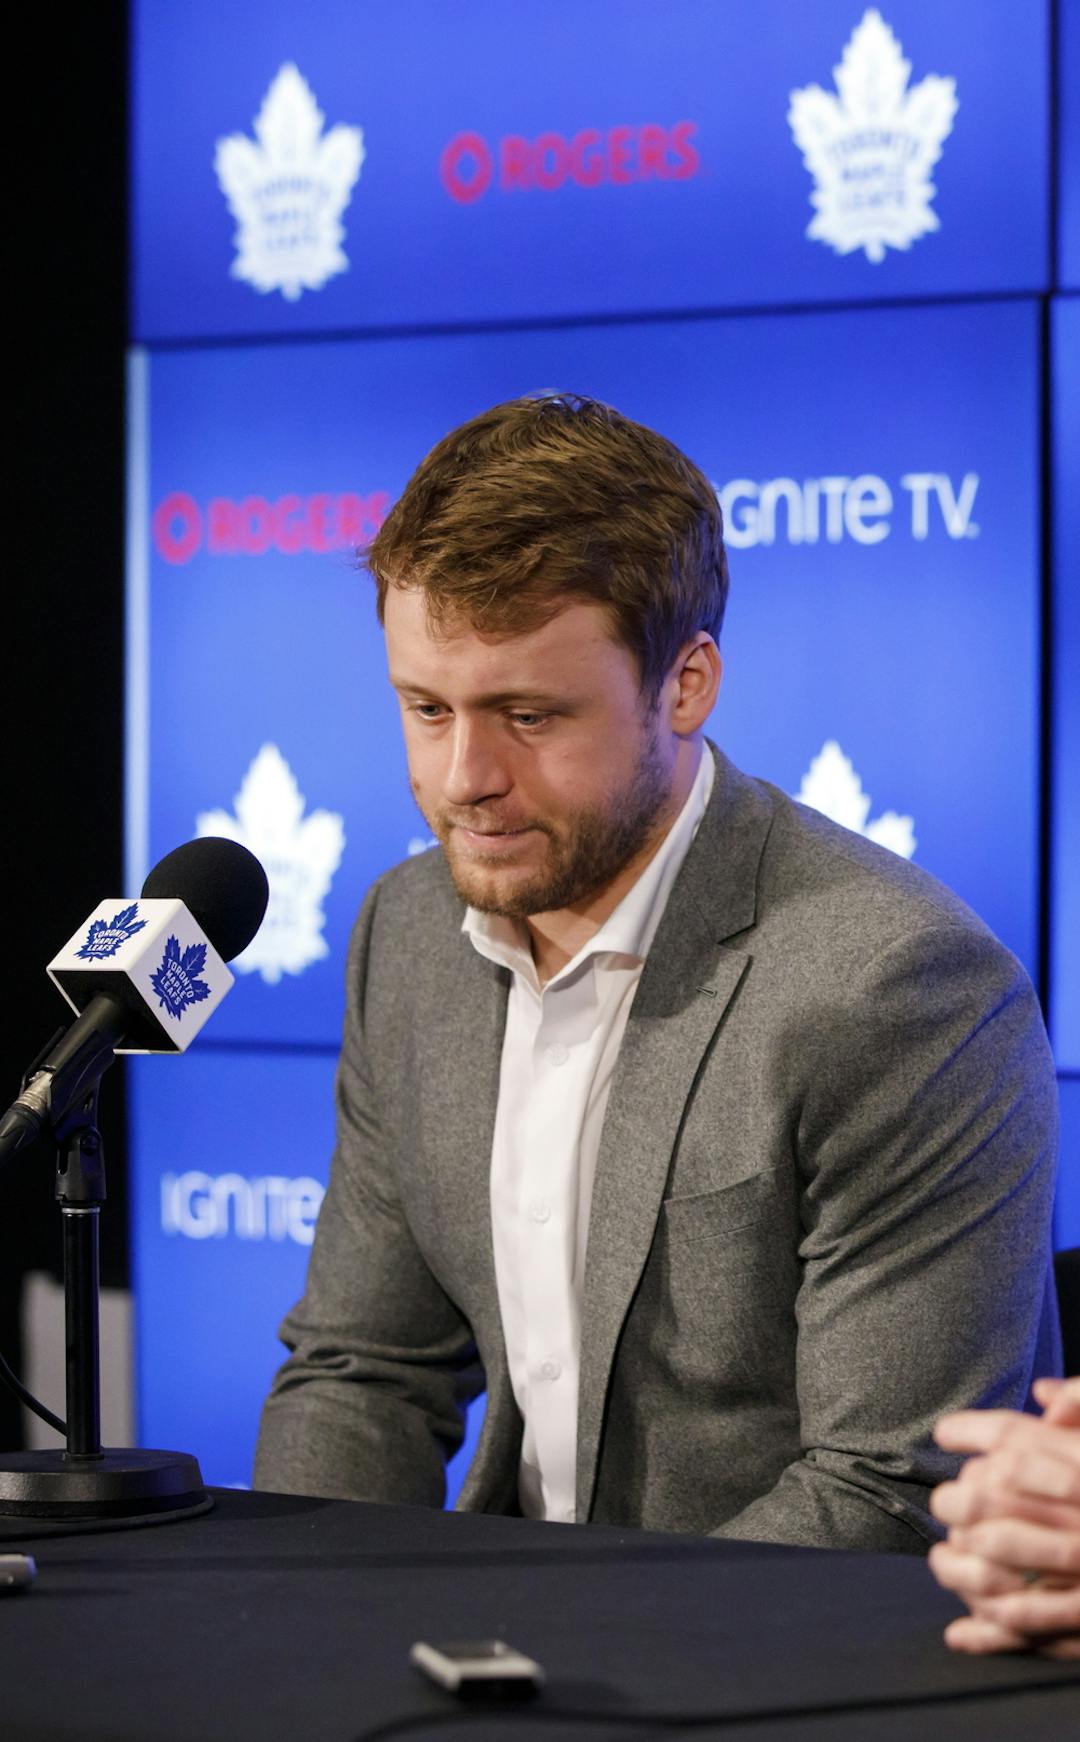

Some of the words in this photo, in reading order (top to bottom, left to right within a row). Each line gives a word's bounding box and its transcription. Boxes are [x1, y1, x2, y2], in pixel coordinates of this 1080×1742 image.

[501, 121, 698, 190] ROGERS
[160, 976, 182, 1005] LEAFS
[166, 969, 187, 999] MAPLE
[167, 958, 195, 999] TORONTO
